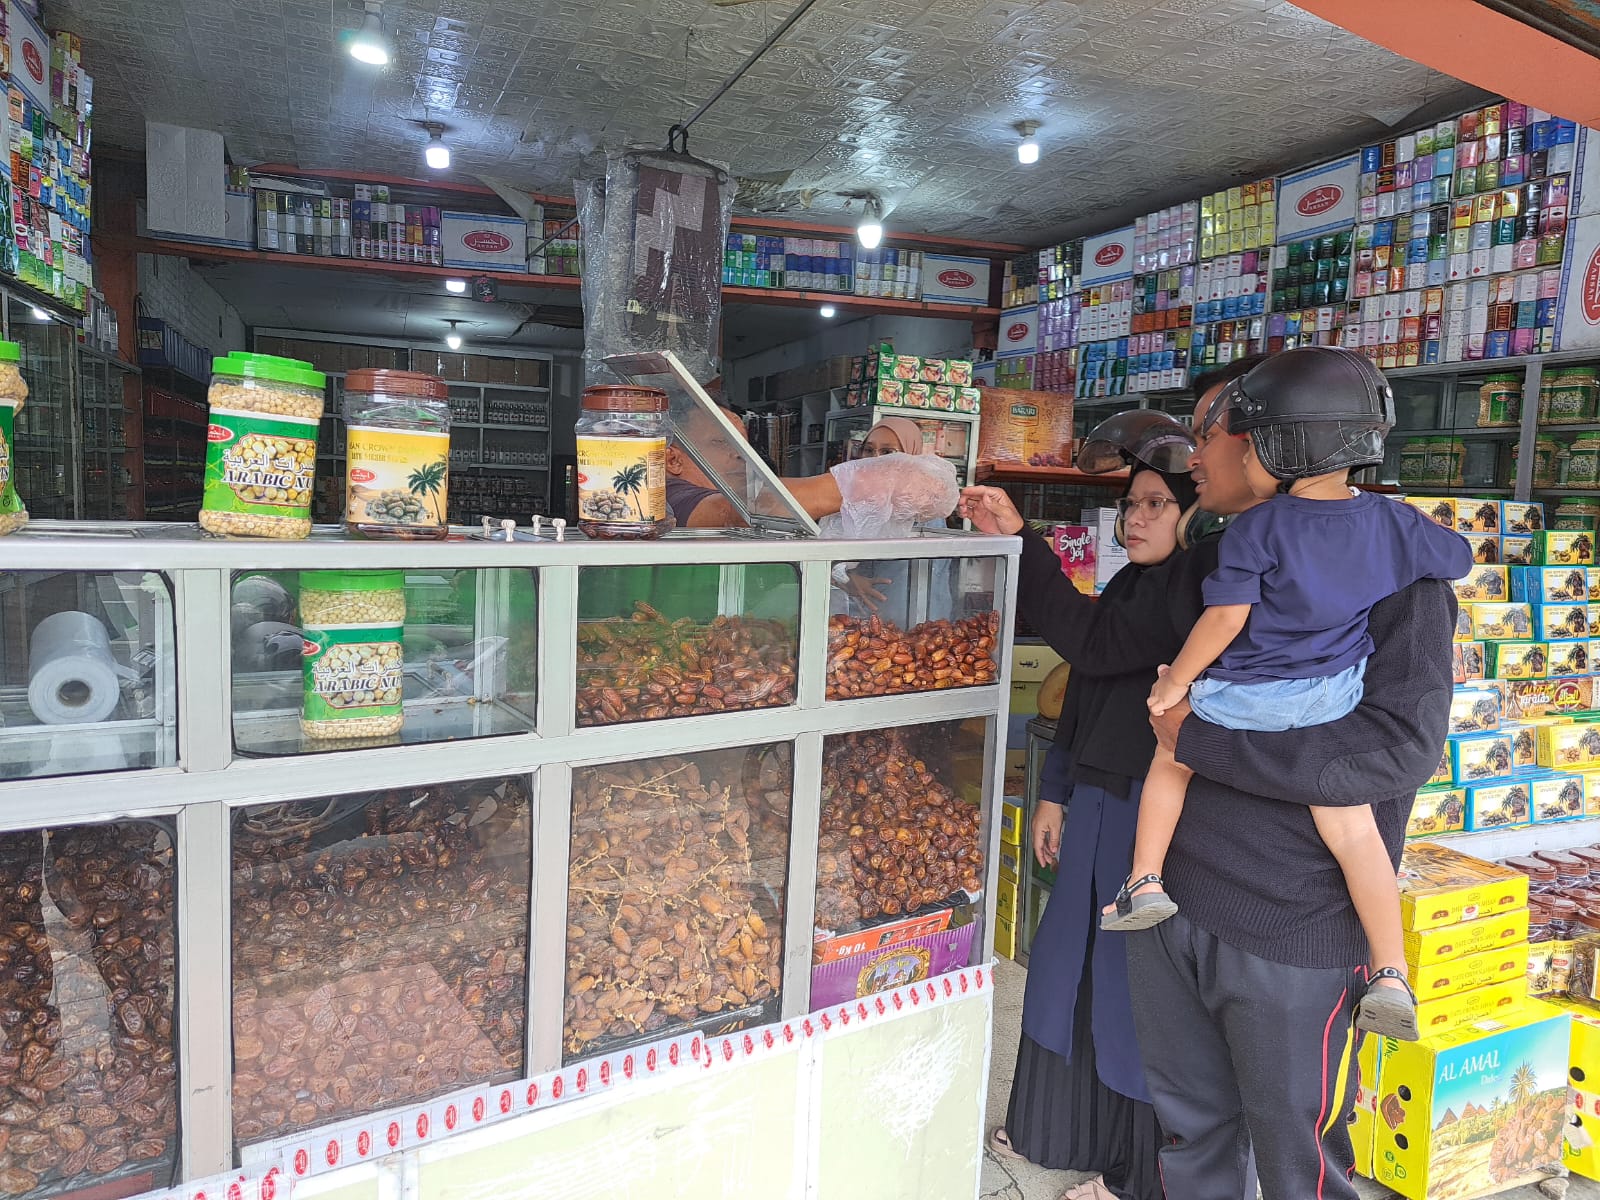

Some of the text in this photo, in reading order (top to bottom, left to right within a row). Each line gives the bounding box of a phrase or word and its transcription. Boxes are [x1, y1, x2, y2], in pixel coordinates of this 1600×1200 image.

[222, 470, 291, 487] ARABIC
[1060, 532, 1091, 551] Single
[1069, 547, 1085, 563] Joy
[314, 678, 377, 692] ARABIC
[854, 942, 866, 953] 10
[1438, 1049, 1501, 1085] AL AMAL
